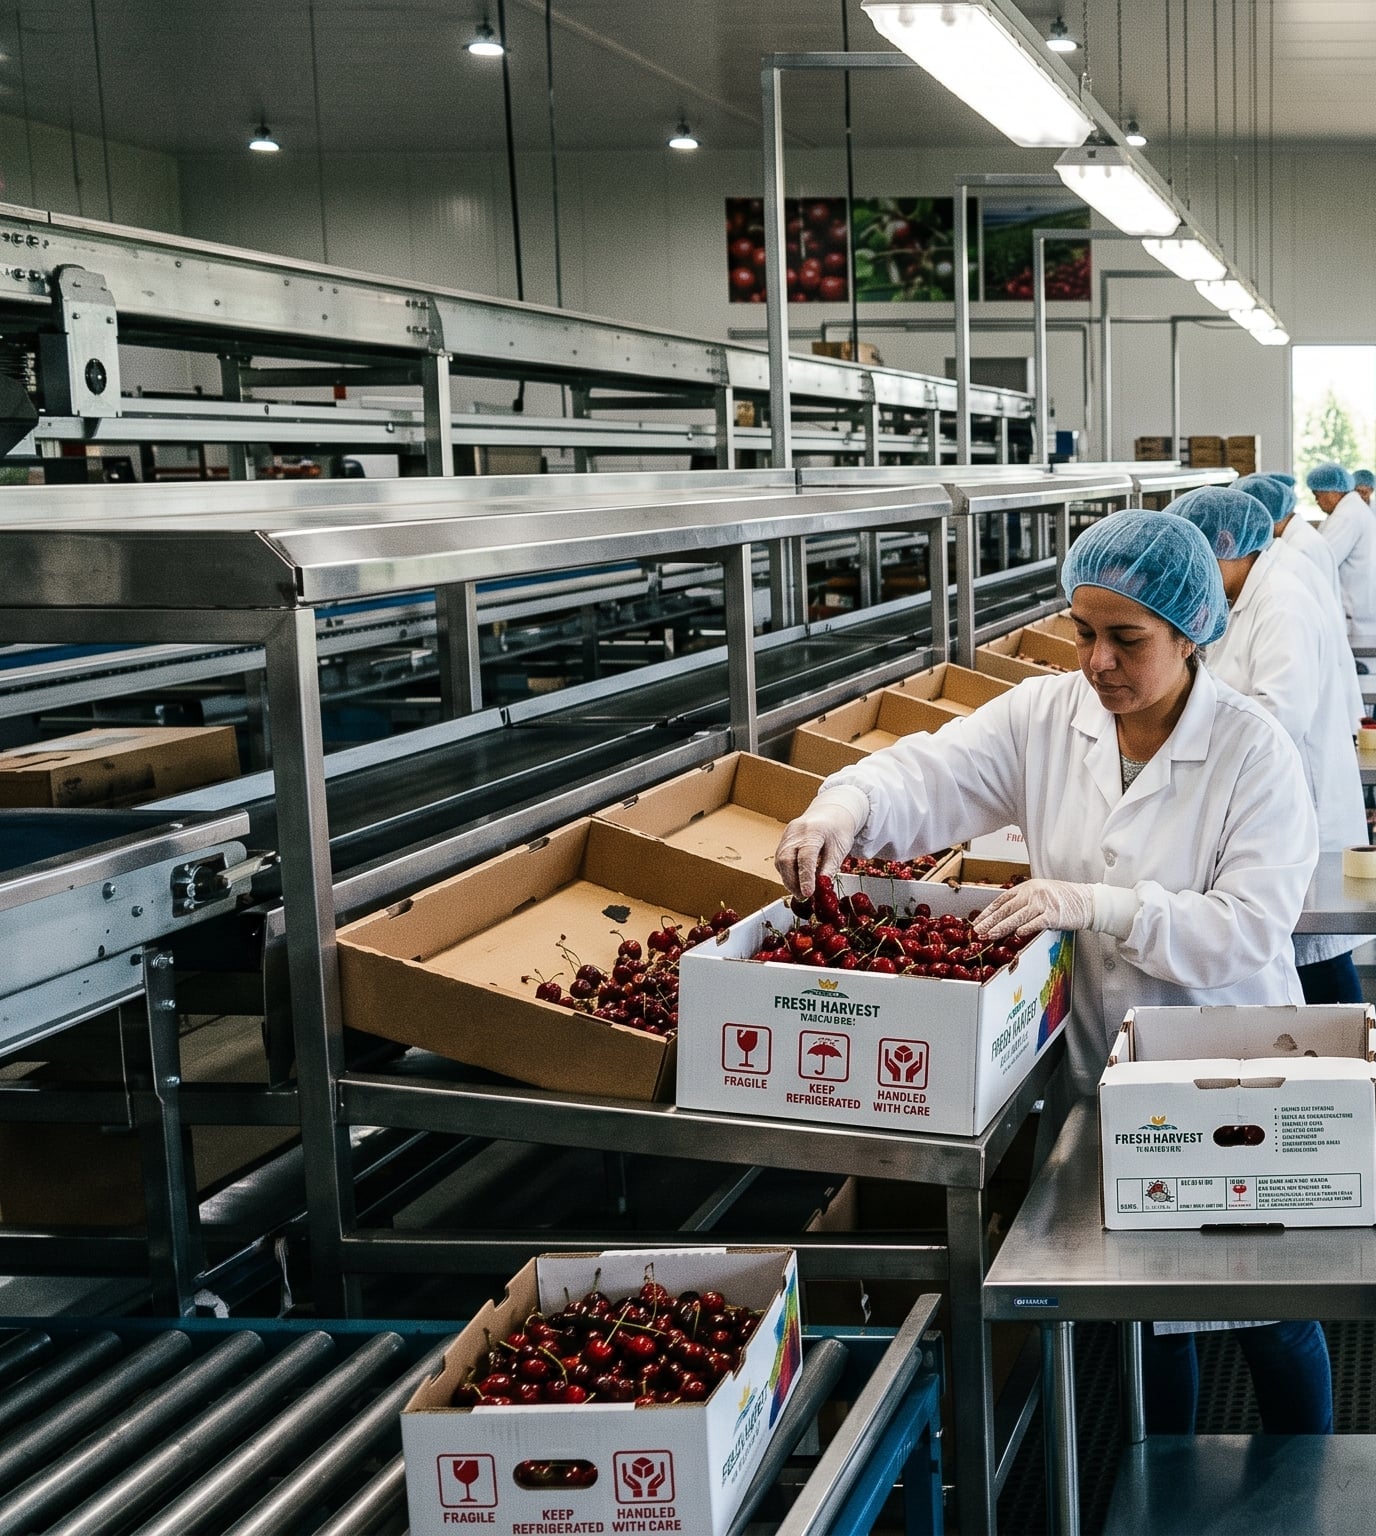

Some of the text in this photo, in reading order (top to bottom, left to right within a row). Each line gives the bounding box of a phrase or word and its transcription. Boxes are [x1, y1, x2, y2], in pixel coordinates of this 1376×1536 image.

[774, 995, 881, 1018] FRESH HARVEST
[724, 1075, 768, 1089] FRAGILE
[809, 1083, 835, 1095] KEEP
[786, 1093, 861, 1110] REFRIGERATED
[877, 1090, 927, 1104] HANDLED
[873, 1102, 931, 1116] WITH CARE
[1115, 1132, 1204, 1144] FRESH HARVEST
[443, 1512, 495, 1524] FRAGILE
[542, 1509, 575, 1521] KEEP
[616, 1507, 676, 1520] HANDLED
[512, 1522, 605, 1535] REFRIGERATED
[612, 1520, 682, 1533] WITH CARE
